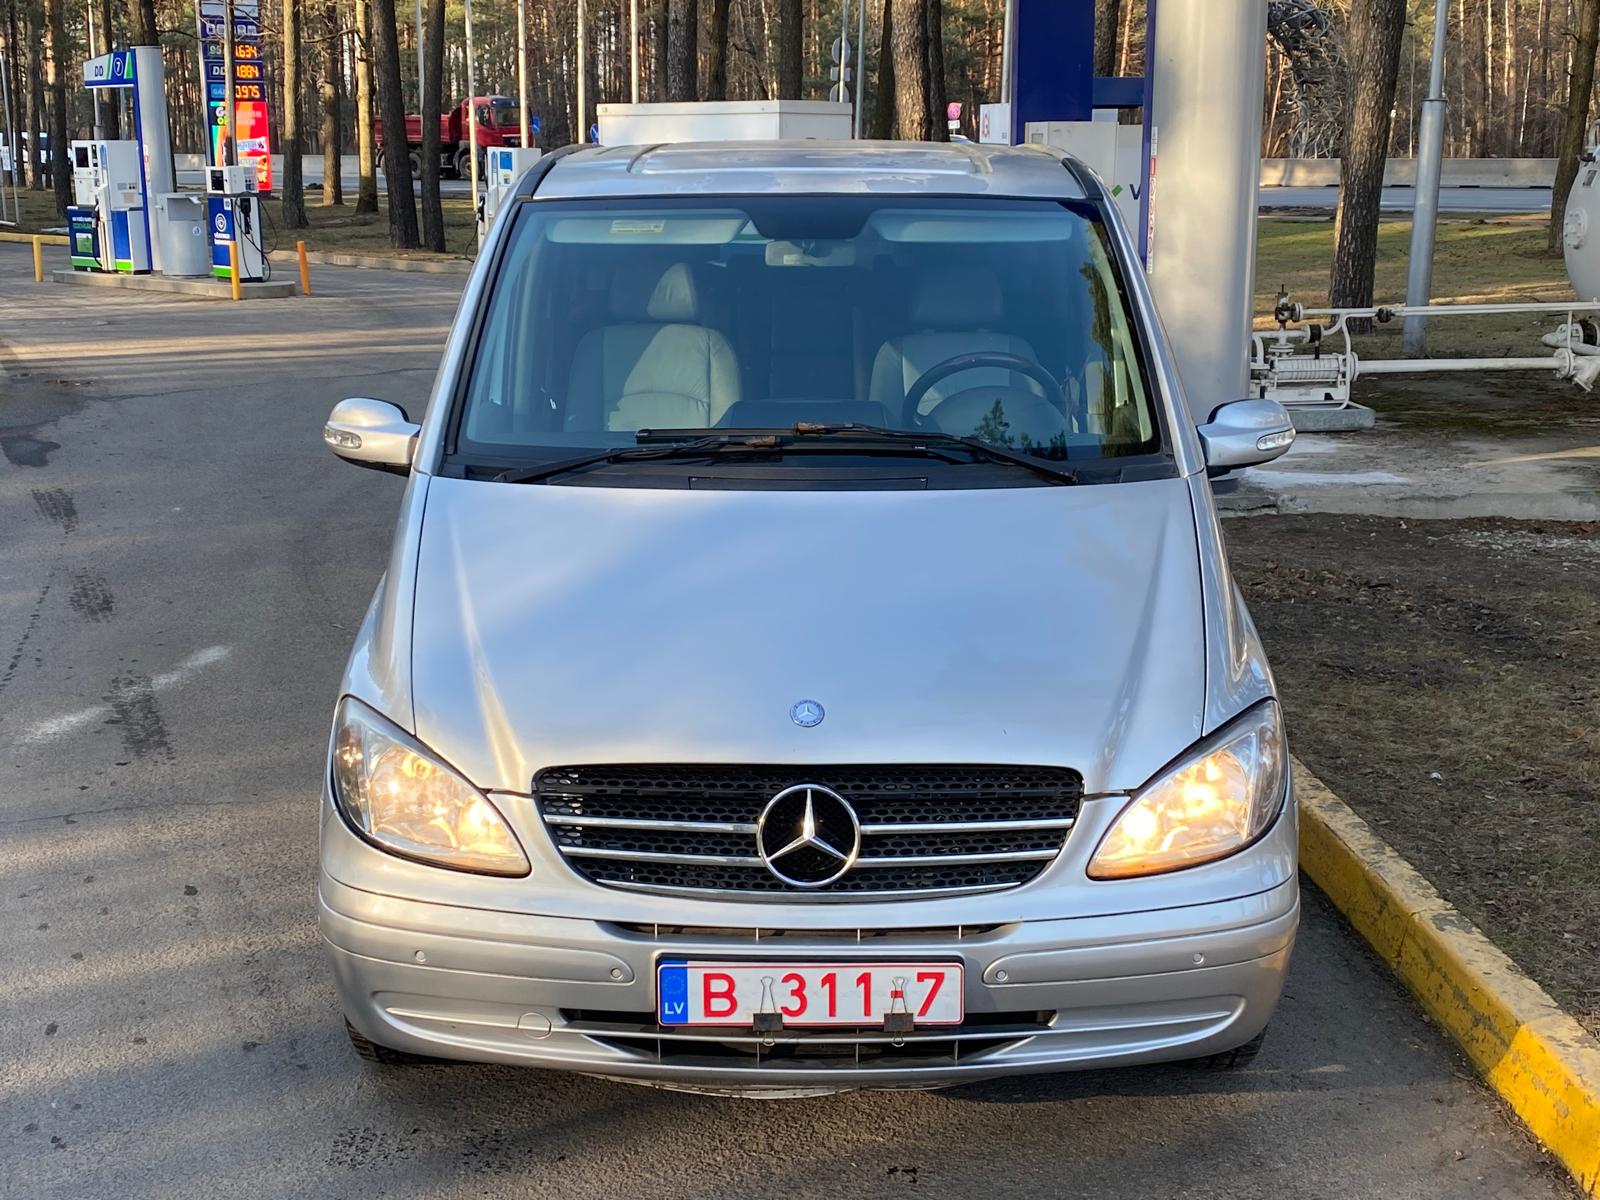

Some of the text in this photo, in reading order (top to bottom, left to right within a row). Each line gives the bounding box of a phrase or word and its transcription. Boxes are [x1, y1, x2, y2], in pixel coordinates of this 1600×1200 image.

[94, 65, 104, 77] DD
[1129, 183, 1141, 201] V
[703, 973, 738, 1017] B
[664, 1002, 684, 1014] LV
